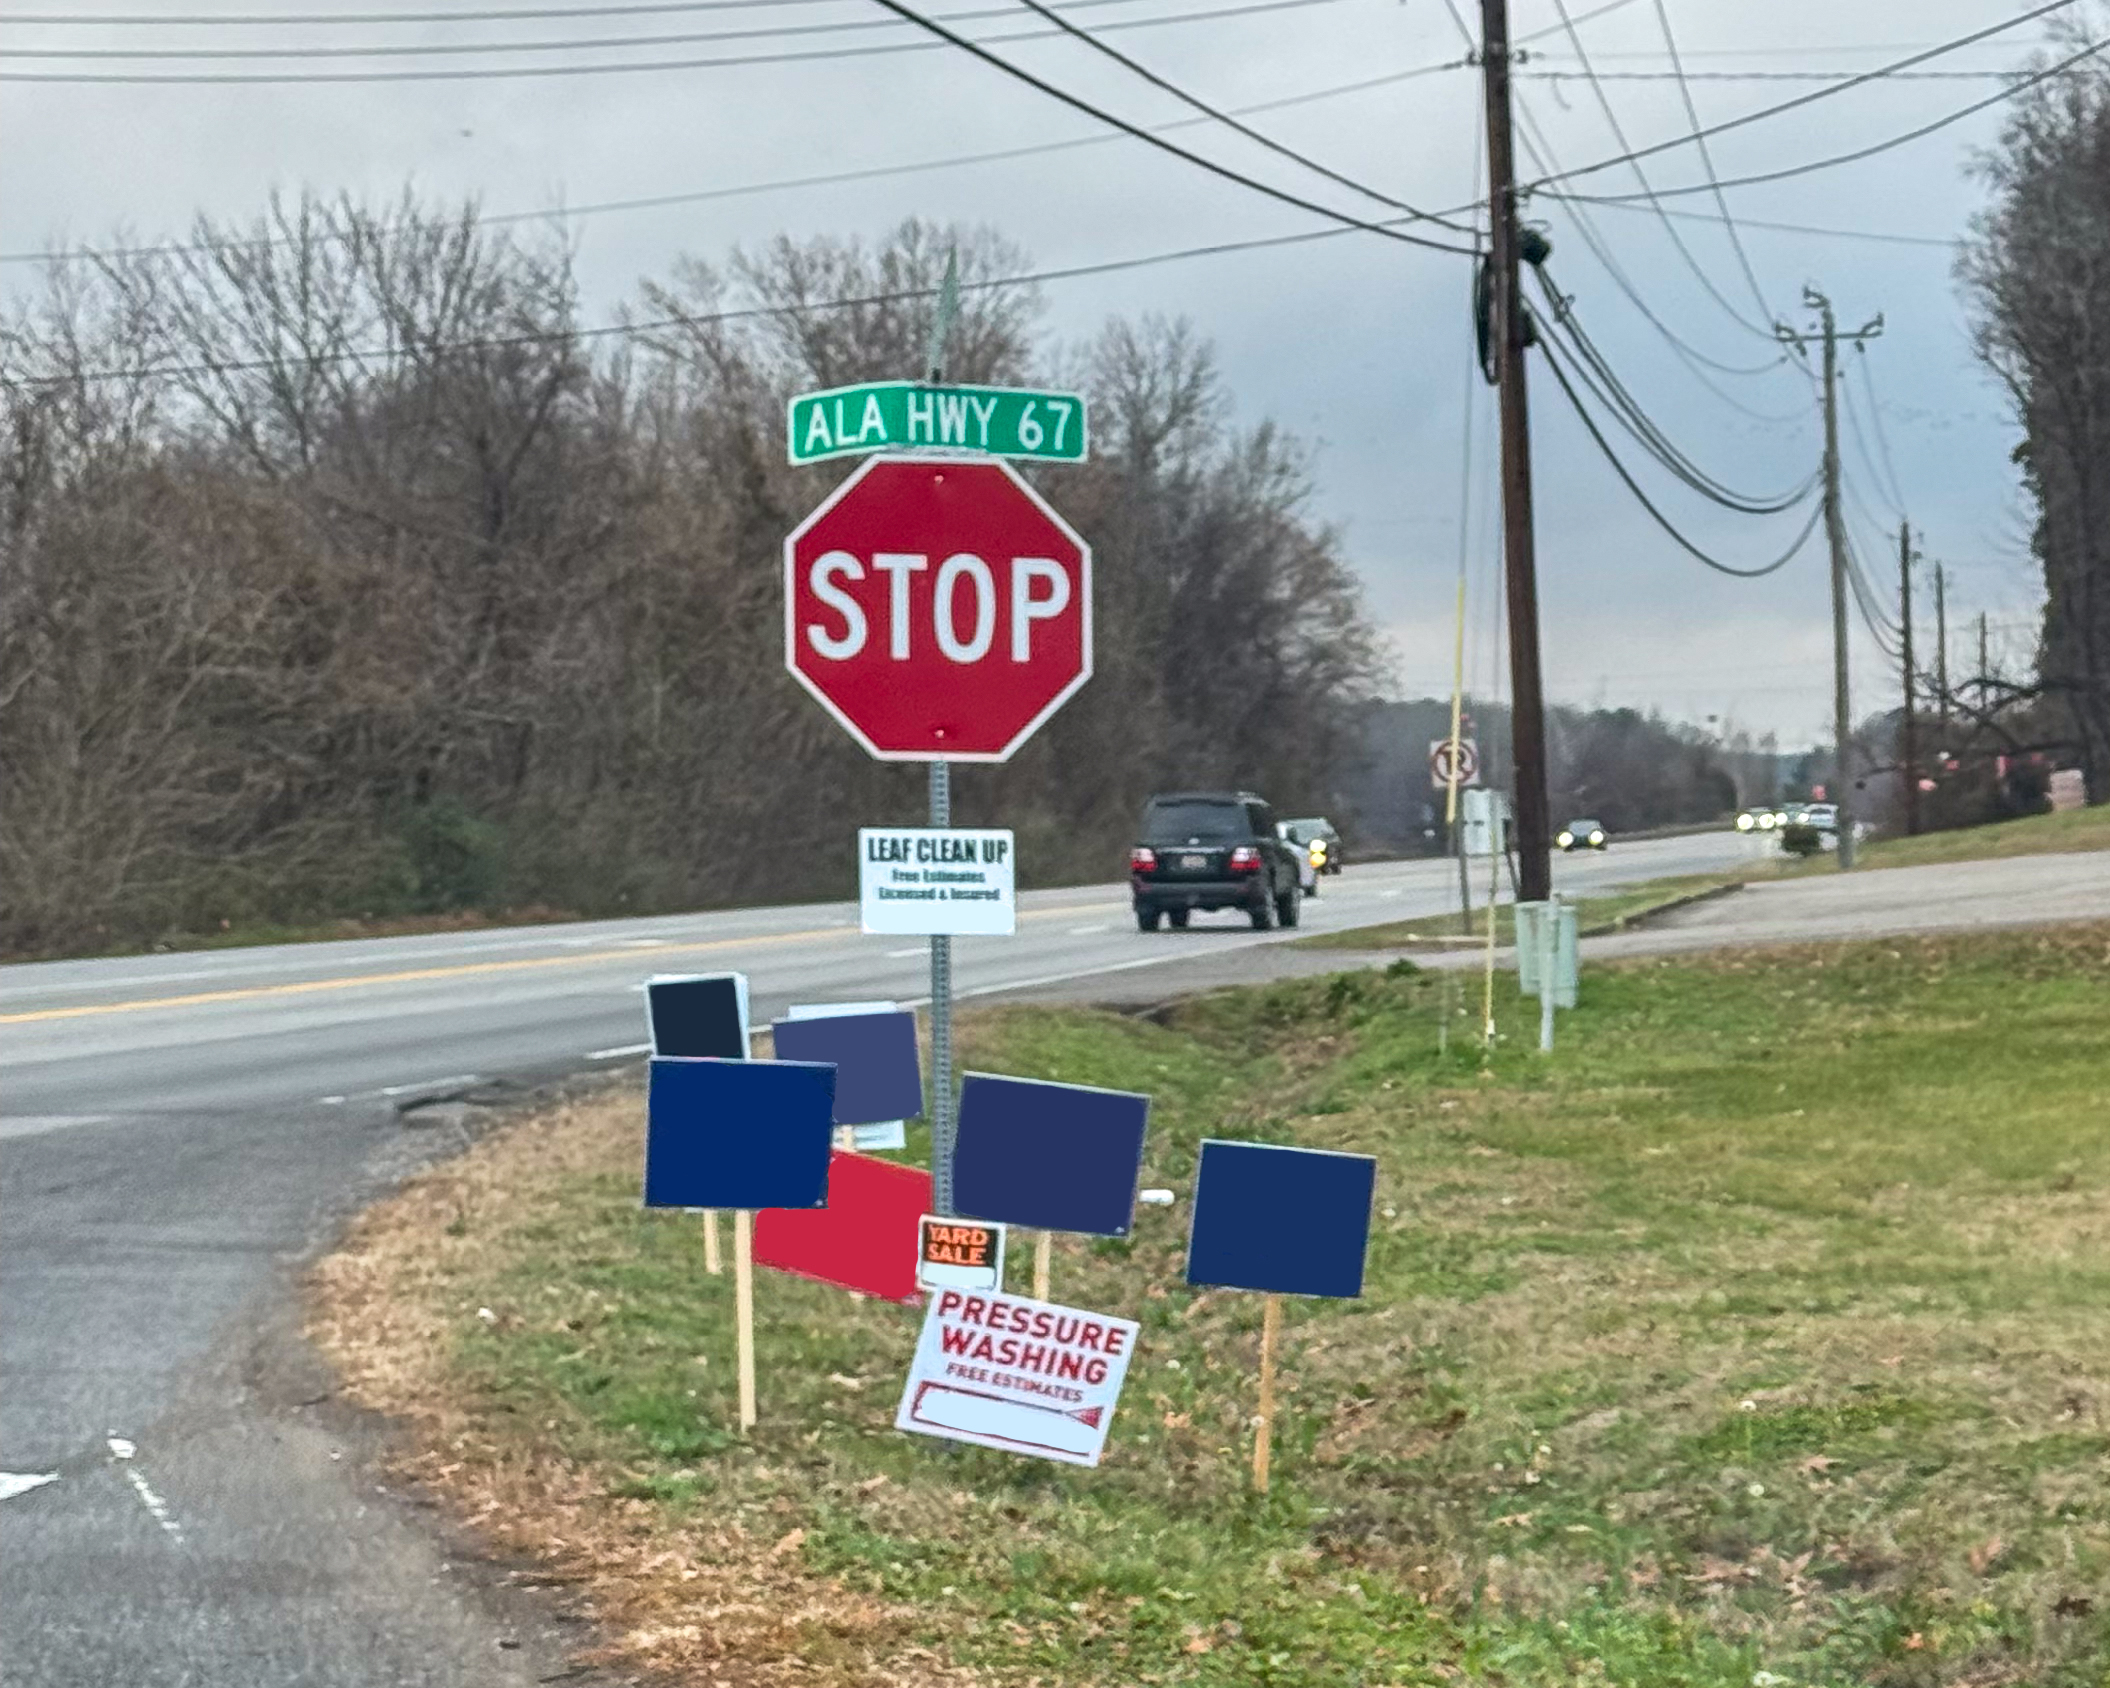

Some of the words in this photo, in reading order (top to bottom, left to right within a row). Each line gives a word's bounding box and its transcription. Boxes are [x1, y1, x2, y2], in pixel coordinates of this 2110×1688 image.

[804, 393, 888, 452] ALA
[906, 391, 998, 446] HWY
[1017, 400, 1072, 450] 67
[806, 549, 1071, 664] STOP
[868, 837, 912, 863] LEAF
[917, 838, 977, 863] CLEAN
[982, 839, 1008, 864] UP
[927, 1243, 986, 1265] SALE
[929, 1224, 988, 1246] YARD
[938, 1290, 1128, 1356] PRESSURE
[941, 1324, 1109, 1386] WASHING
[946, 1362, 988, 1383] FREE
[992, 1372, 1084, 1403] ESTIMATES
